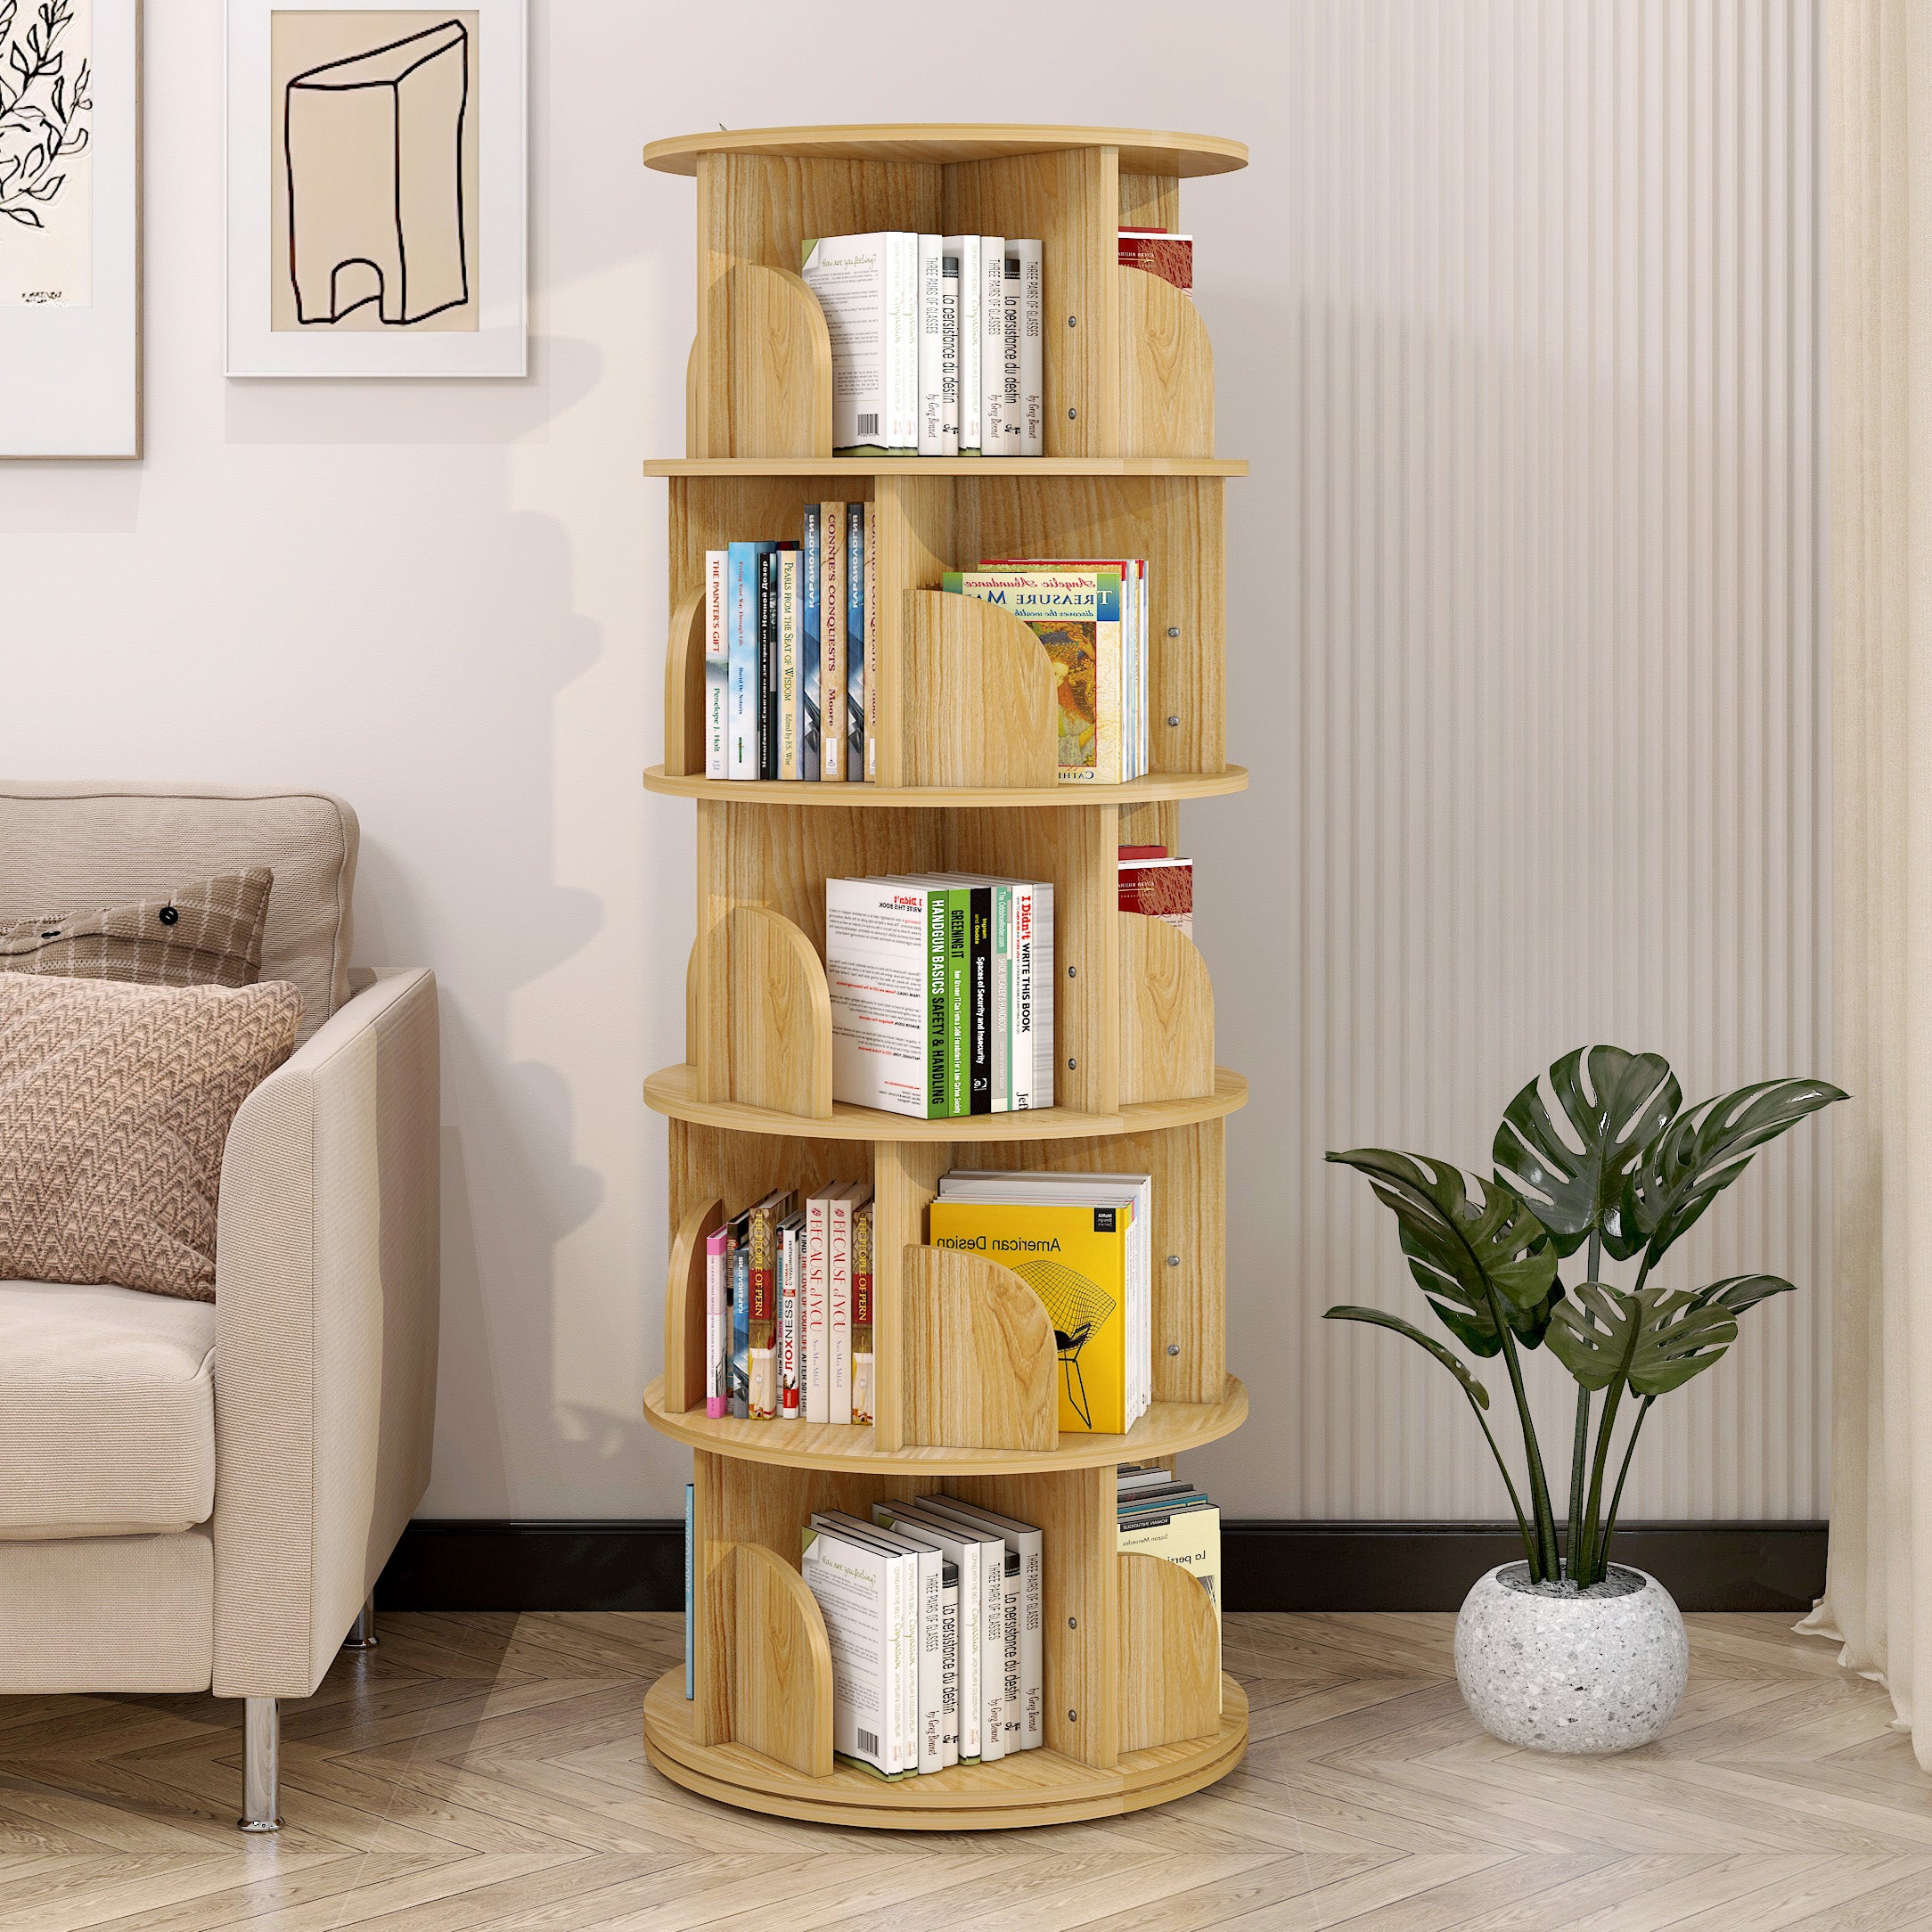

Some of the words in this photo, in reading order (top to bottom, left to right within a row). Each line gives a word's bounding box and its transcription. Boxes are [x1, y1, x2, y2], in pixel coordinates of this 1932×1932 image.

[1027, 262, 1038, 280] THREE
[1005, 296, 1020, 306] La
[1027, 282, 1038, 299] PAIRS
[1005, 309, 1020, 360] persistance
[1027, 311, 1038, 337] GLASSES
[1005, 363, 1020, 374] du
[1005, 378, 1020, 404] destin
[1027, 405, 1039, 417] Greg
[1028, 420, 1039, 438] Bennet
[784, 563, 793, 590] PEARLS
[827, 585, 836, 671] CONQUESTS
[784, 634, 793, 652] SEAT
[784, 655, 791, 665] OF
[784, 667, 793, 701] WISDOM
[713, 688, 721, 724] Penelope
[713, 735, 721, 752] Holt
[998, 891, 1006, 900] The
[932, 900, 945, 953] HANDGUN
[952, 910, 964, 949] GREENING
[1022, 905, 1030, 940] Didn't
[976, 957, 985, 980] Spaces
[998, 959, 1006, 973] SHOE
[1022, 943, 1030, 975] WRITE
[932, 956, 945, 995] BASICS
[998, 974, 1006, 1003] WEARER'S
[1022, 977, 1030, 1000] THIS
[976, 989, 985, 1017] Security
[932, 998, 945, 1036] SAFETY
[998, 1003, 1006, 1034] HANDBOOK
[1022, 1003, 1030, 1033] BOOK
[932, 1039, 945, 1047] &
[976, 1031, 985, 1064] Insecurity
[932, 1051, 945, 1104] HANDLING
[953, 1098, 962, 1114] Society
[810, 1220, 823, 1284] BECAUSE
[833, 1221, 846, 1285] BECAUSE
[756, 1273, 763, 1289] OF
[802, 1297, 807, 1306] OF
[810, 1289, 823, 1298] of
[833, 1289, 846, 1298] of
[810, 1300, 823, 1333] YOU
[833, 1301, 846, 1333] YOU
[1027, 1553, 1038, 1572] THREE
[1027, 1575, 1038, 1592] PAIRS
[1005, 1592, 1020, 1604] La
[1027, 1593, 1038, 1601] OF
[1027, 1604, 1038, 1631] GLASSES
[1005, 1607, 1020, 1658] persistance
[1005, 1660, 1020, 1672] du
[1005, 1675, 1020, 1702] destin
[1027, 1697, 1039, 1711] Greg
[1028, 1713, 1039, 1731] Bennet
